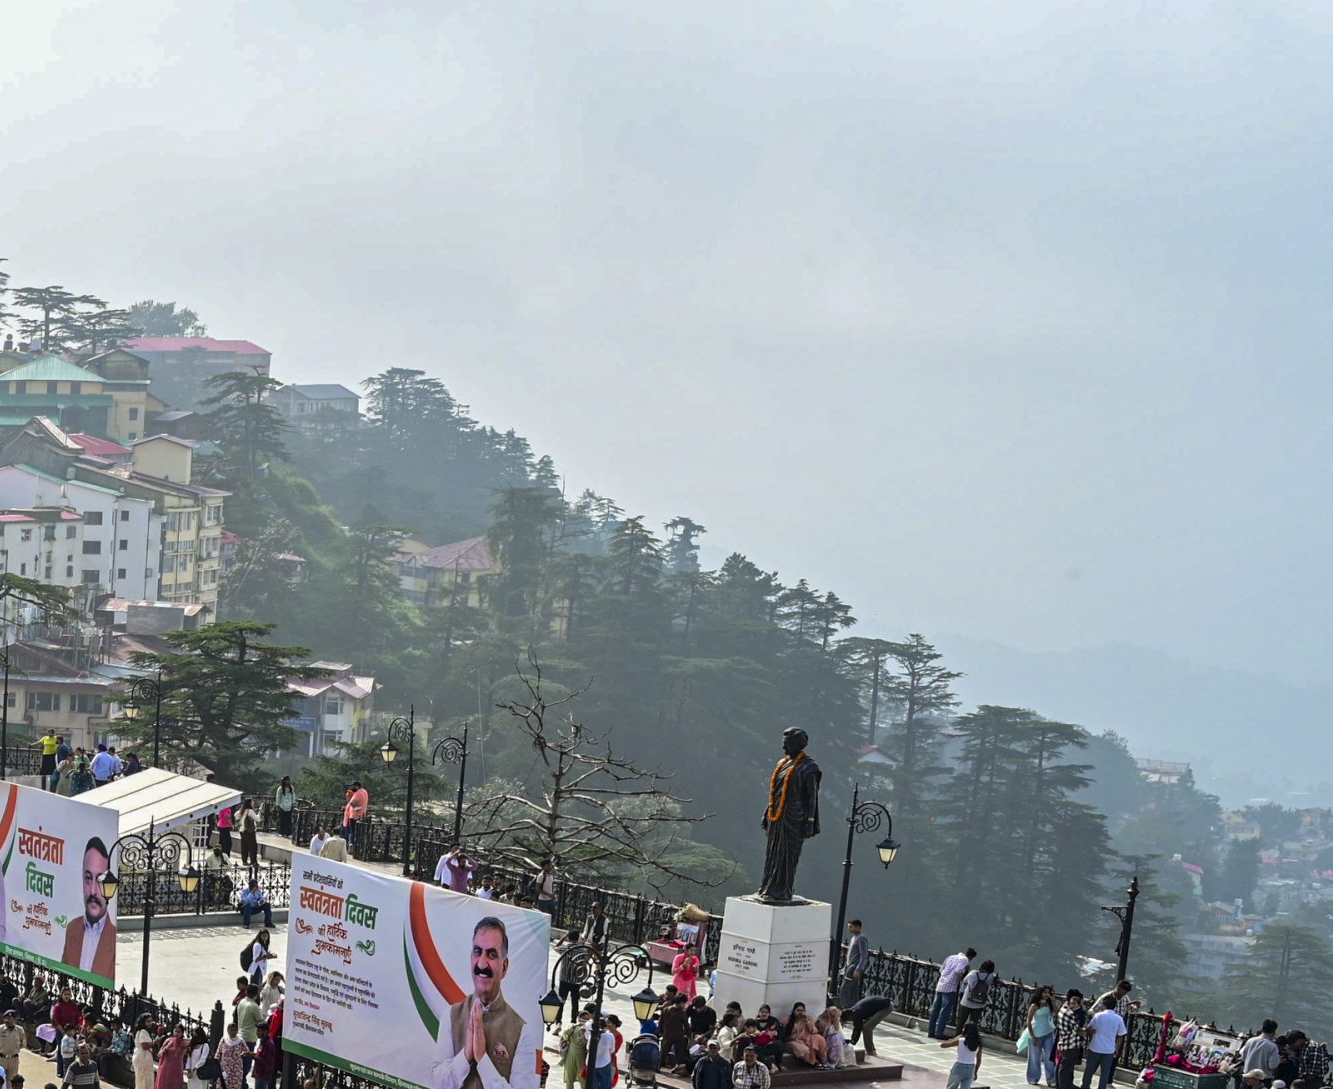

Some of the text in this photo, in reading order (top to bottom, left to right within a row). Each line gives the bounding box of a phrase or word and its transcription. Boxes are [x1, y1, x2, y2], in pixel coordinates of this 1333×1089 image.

[18, 826, 65, 865] स्वतंत्रता
[25, 861, 55, 898] दिवस
[300, 886, 378, 929] स्वतंत्रता दिवस
[318, 922, 347, 941] की हार्दिक
